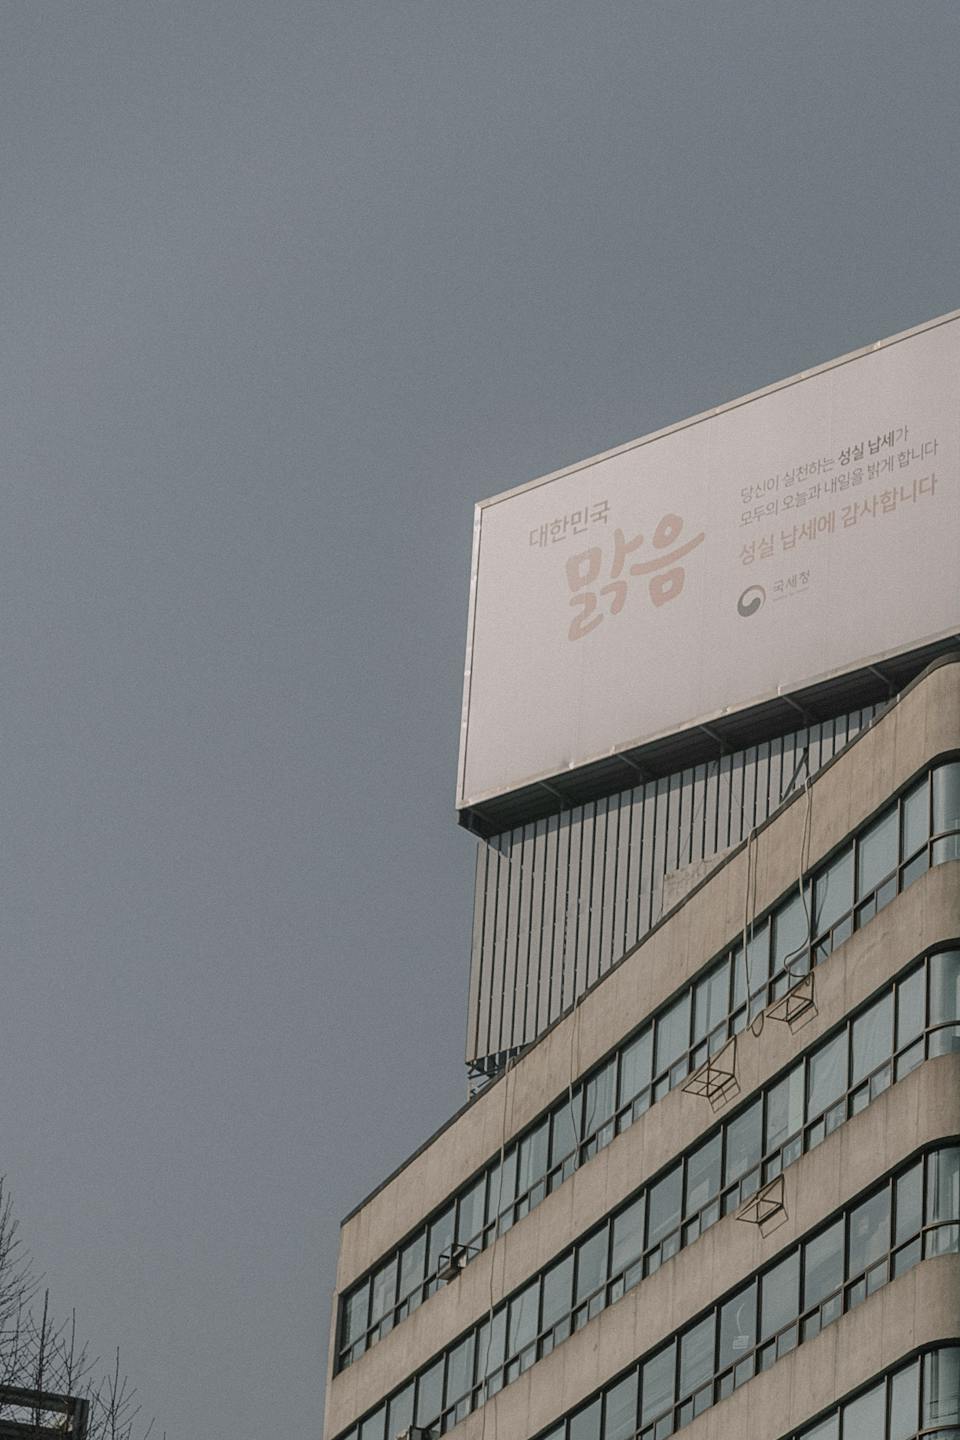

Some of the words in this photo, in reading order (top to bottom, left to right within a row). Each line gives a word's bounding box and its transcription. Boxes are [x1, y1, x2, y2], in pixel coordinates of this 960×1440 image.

[739, 475, 780, 504] 당신이
[783, 456, 836, 488] 실천하는
[838, 442, 865, 466] 성실
[867, 425, 909, 455] 납세가
[739, 499, 779, 527] 모두의
[782, 483, 823, 511] 오늘과
[824, 467, 865, 493] 내일을
[867, 455, 895, 480] 밝게
[897, 438, 939, 468] 합니다
[528, 500, 611, 547] 대한민국
[739, 533, 775, 566] 성실
[780, 510, 836, 551] 납세에
[841, 473, 938, 529] 감사합니다
[565, 513, 705, 642] 맑음
[773, 569, 811, 593] 국세청
